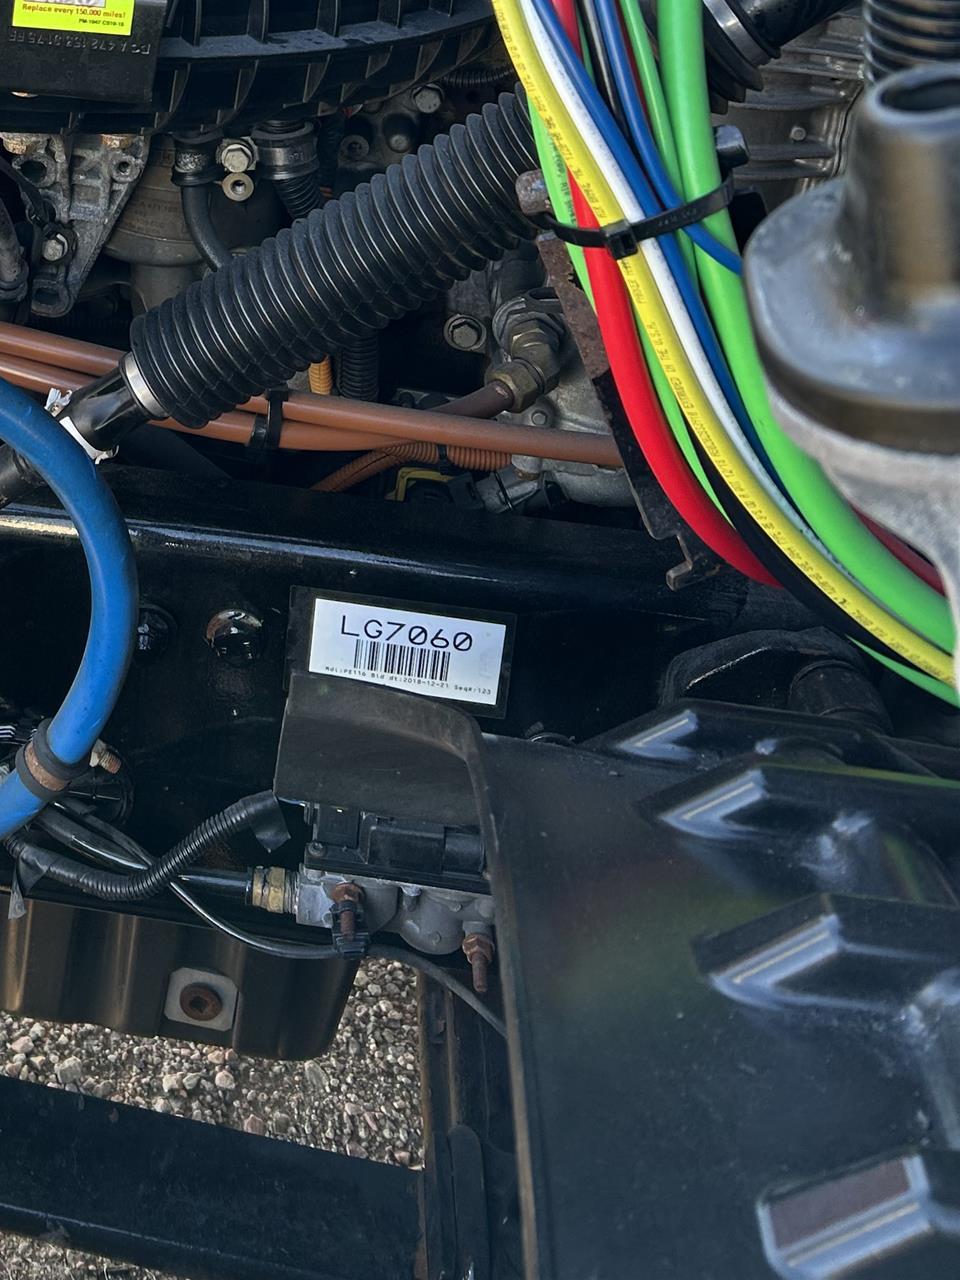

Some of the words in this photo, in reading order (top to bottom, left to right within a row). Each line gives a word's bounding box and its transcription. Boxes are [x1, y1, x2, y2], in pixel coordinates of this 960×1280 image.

[22, 4, 52, 13] Replace
[54, 7, 74, 16] every
[103, 11, 125, 19] miles!
[341, 615, 473, 651] LG7060
[371, 672, 385, 680] Bld
